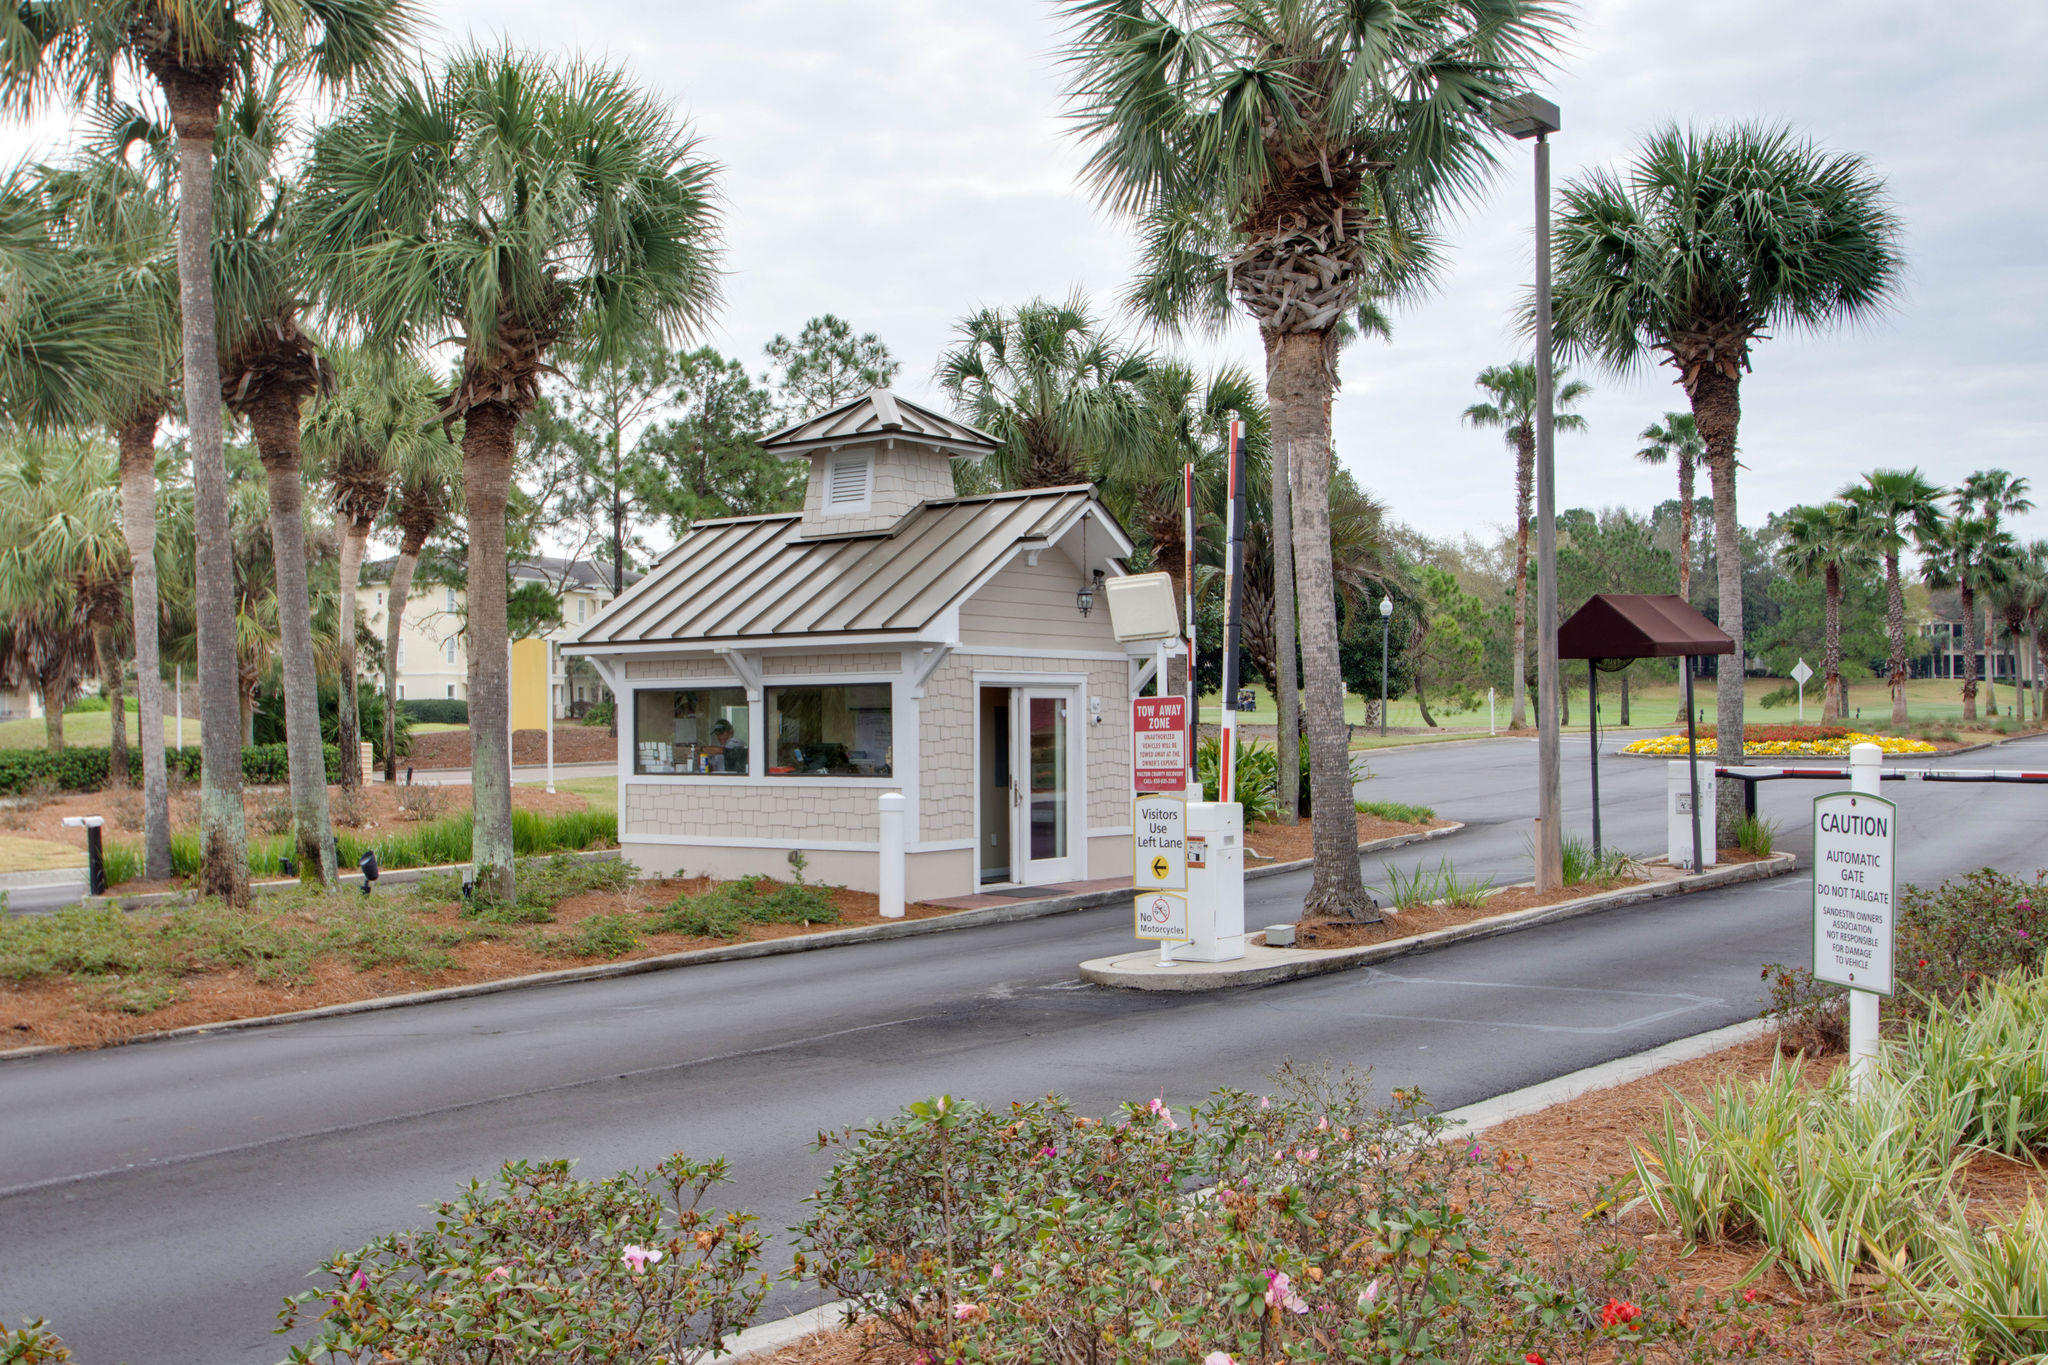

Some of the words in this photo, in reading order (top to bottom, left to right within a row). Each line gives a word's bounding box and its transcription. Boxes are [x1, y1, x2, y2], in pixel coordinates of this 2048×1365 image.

[1137, 705, 1154, 717] TOW
[1159, 704, 1181, 716] AWAY
[1149, 717, 1170, 729] ZONE
[1144, 733, 1175, 741] UNAUTHORIZED
[1141, 808, 1178, 820] Visitors
[1149, 822, 1167, 834] Use
[1820, 813, 1888, 838] CAUTION
[1137, 836, 1157, 848] Left
[1159, 837, 1183, 849] Lane
[1826, 850, 1880, 868] AUTOMATIC
[1841, 869, 1864, 883] GATE
[1817, 884, 1829, 896] DO
[1831, 885, 1848, 898] NOT
[1850, 888, 1889, 905] TAILGATE
[1140, 912, 1152, 922] No
[1822, 906, 1855, 920] SANDESTIN
[1856, 911, 1883, 924] OWNERS
[1140, 924, 1184, 935] Motorcycles
[1832, 920, 1873, 934] ASSOCIATION
[1826, 930, 1839, 940] NOT
[1840, 932, 1879, 947] RESPONSIBLE
[1832, 943, 1844, 953] FOR
[1844, 945, 1872, 959] DAMAGE
[1835, 955, 1844, 965] TO
[1845, 957, 1869, 969] VEHICLE
